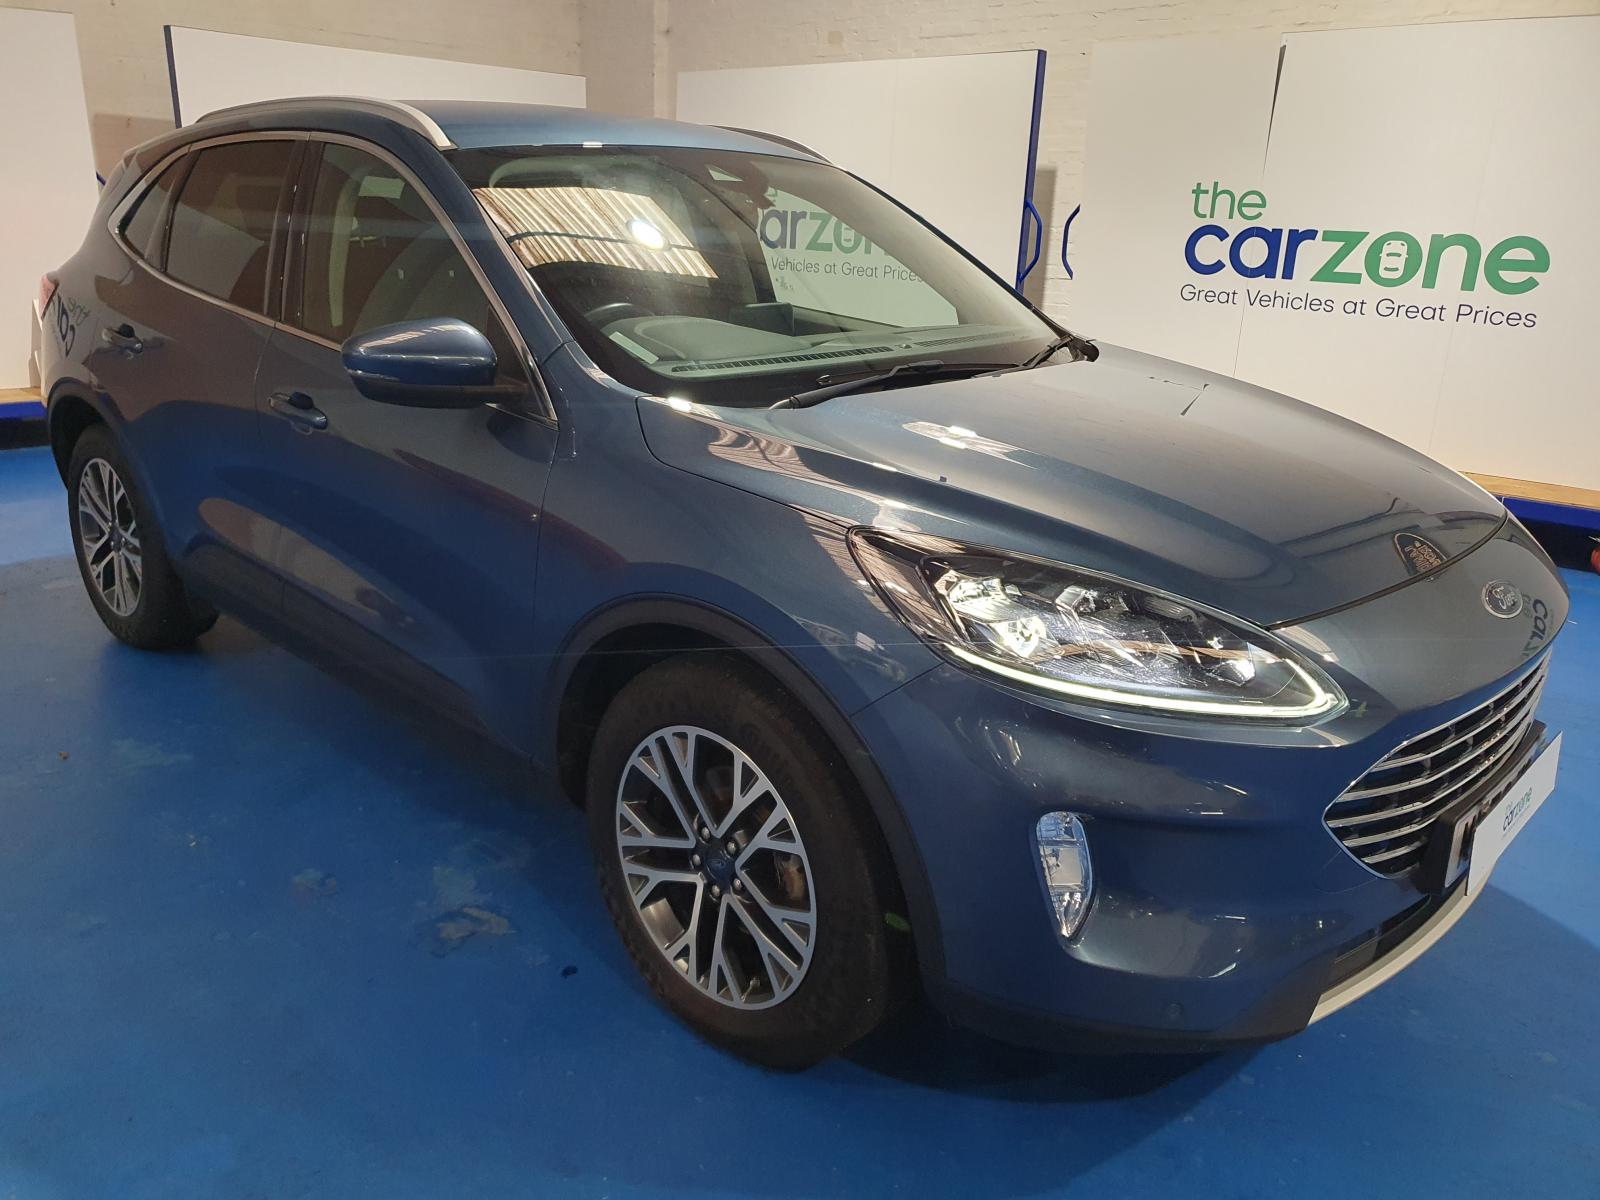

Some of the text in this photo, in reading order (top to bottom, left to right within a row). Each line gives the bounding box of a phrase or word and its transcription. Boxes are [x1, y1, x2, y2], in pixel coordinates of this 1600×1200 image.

[1191, 181, 1267, 221] the
[770, 256, 820, 274] Vehicles
[824, 262, 838, 275] at
[841, 261, 879, 279] Great
[1184, 224, 1551, 296] carzone
[1179, 283, 1538, 329] Great Vehicles at Great Prices
